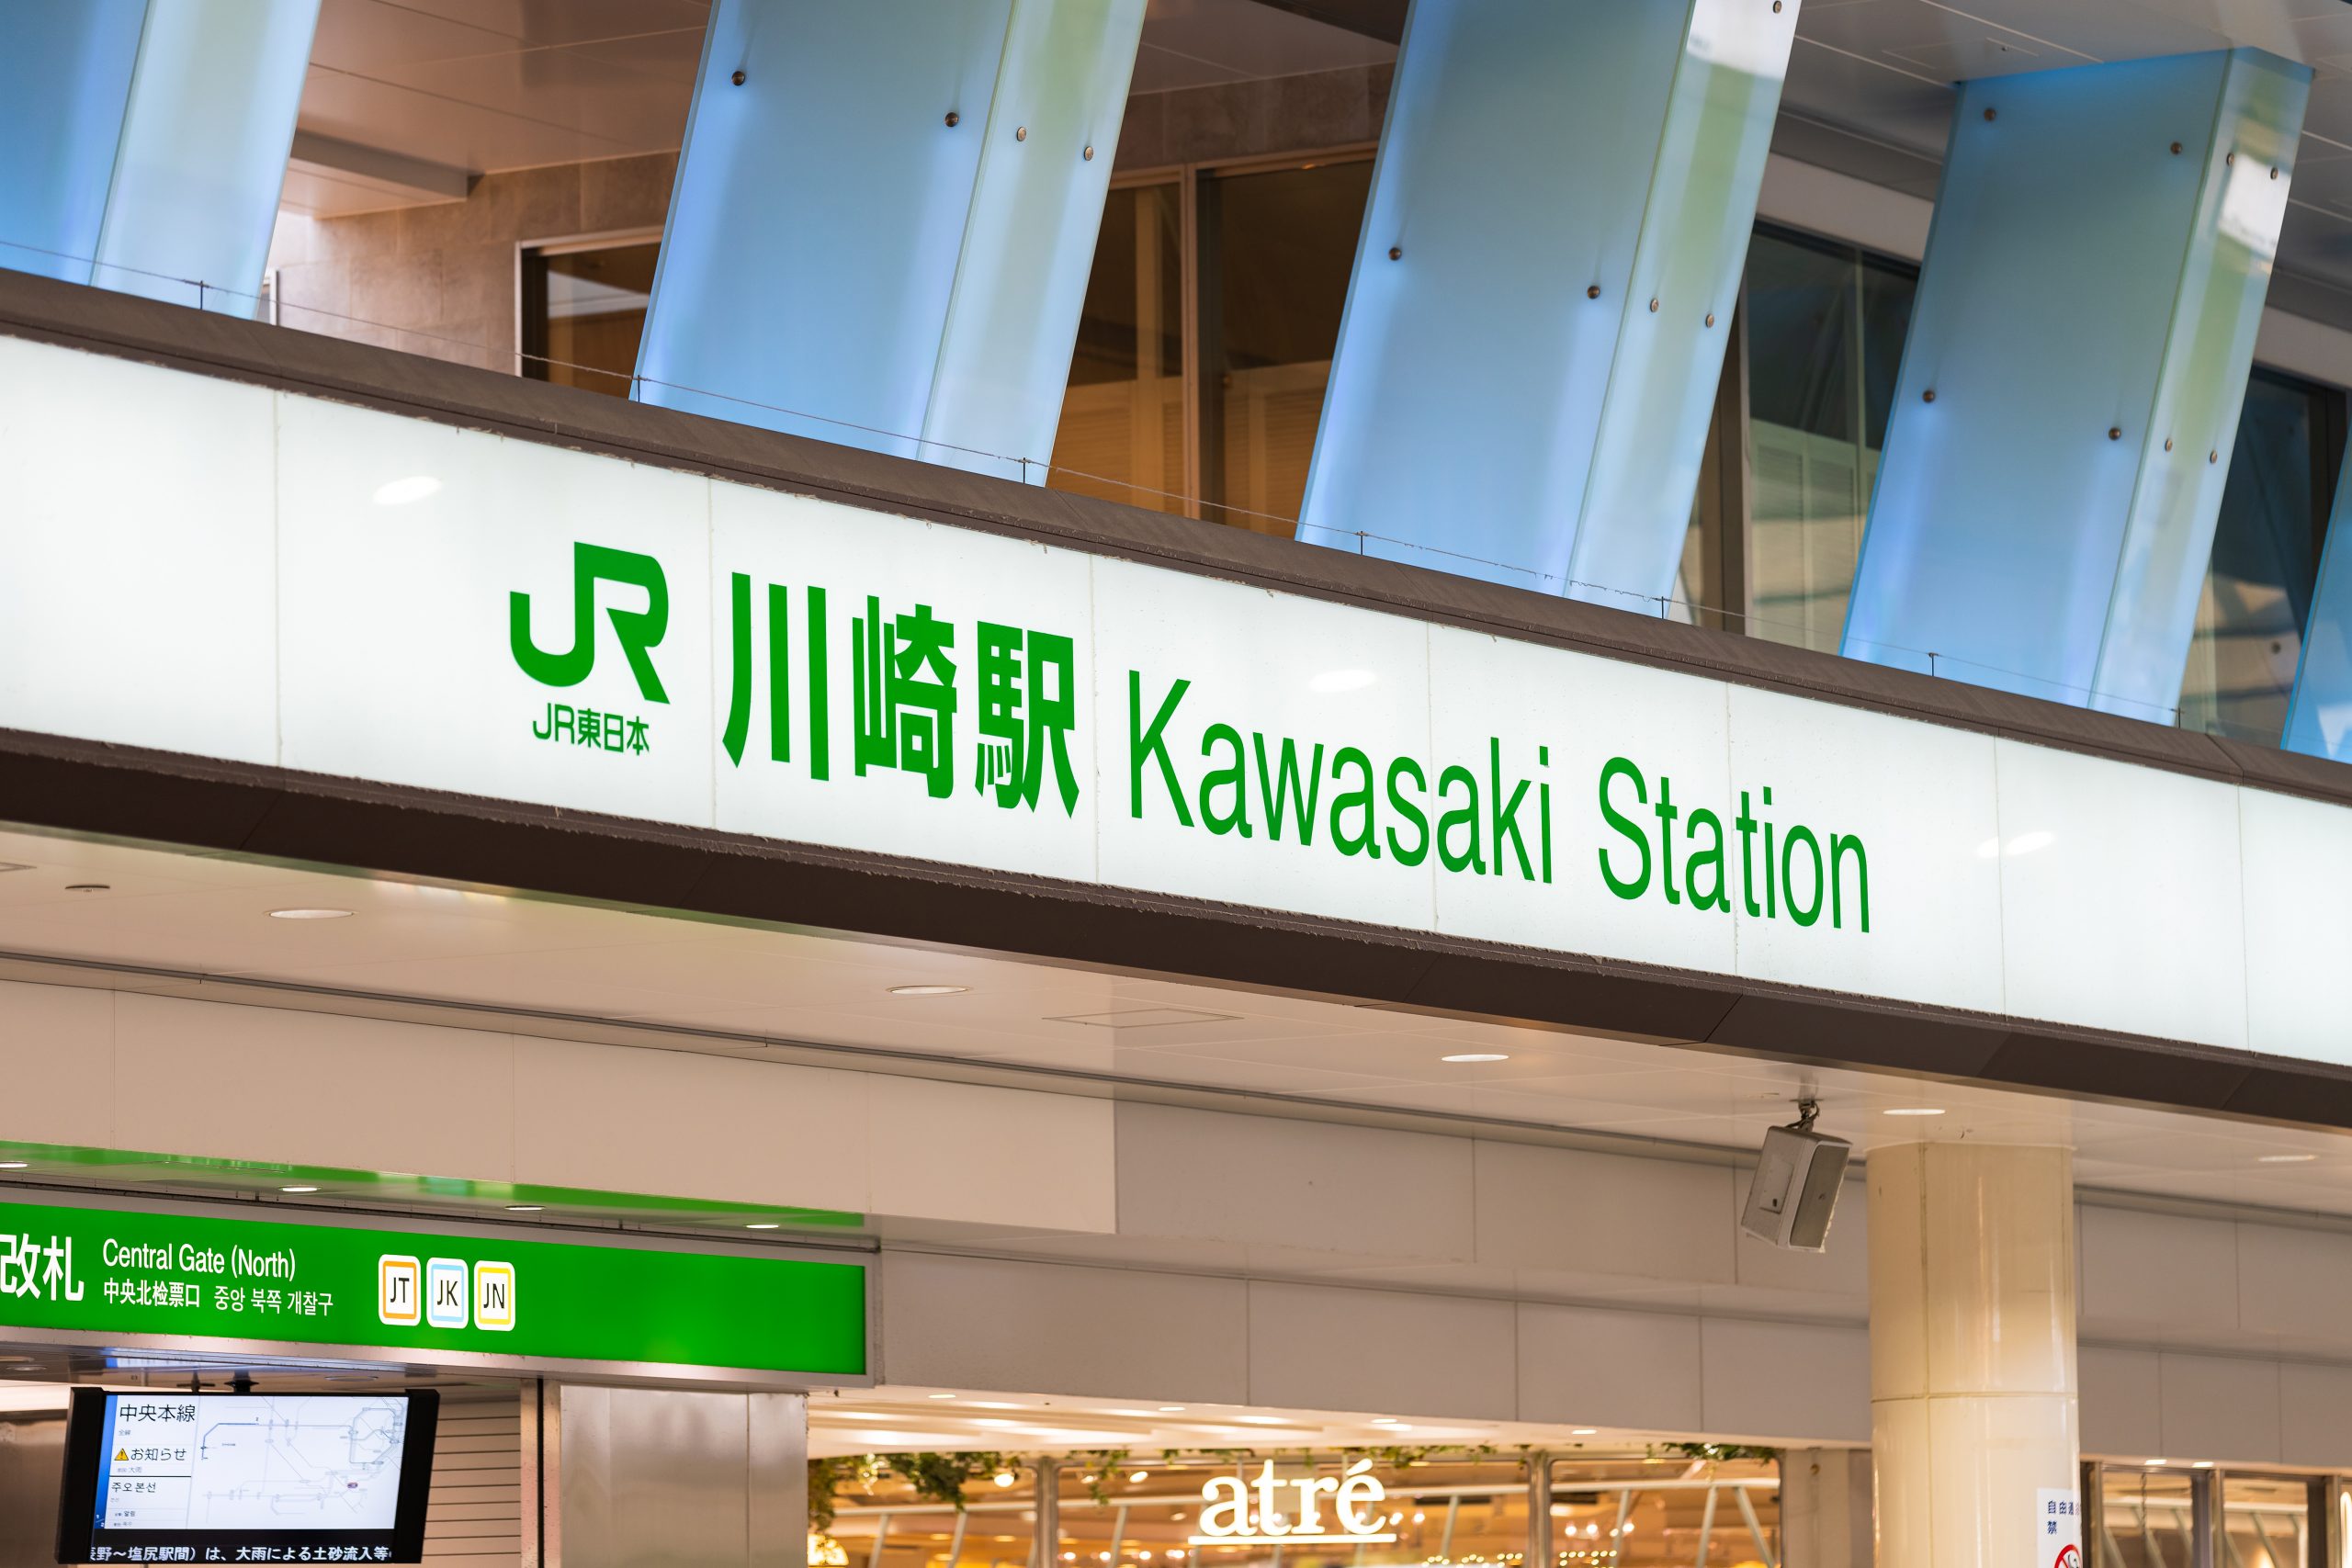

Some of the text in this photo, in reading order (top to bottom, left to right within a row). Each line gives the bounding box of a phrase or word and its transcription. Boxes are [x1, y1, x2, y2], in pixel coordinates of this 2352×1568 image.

[510, 541, 670, 705] JR
[722, 572, 1080, 818] 川崎駅
[533, 701, 650, 756] JR東日本
[1128, 670, 1870, 934] Kawasaki Station
[0, 1233, 85, 1301] 改札
[103, 1238, 296, 1282] Central Gate (North)
[104, 1278, 200, 1308] 中央北检票口
[214, 1285, 334, 1316] 중앙 북쪽 개찰구
[390, 1277, 410, 1303] JT
[436, 1280, 458, 1306] JK
[483, 1282, 505, 1309] JN
[119, 1404, 196, 1423] 中央本線
[130, 1448, 187, 1461] お知らせ
[1199, 1459, 1386, 1536] atré
